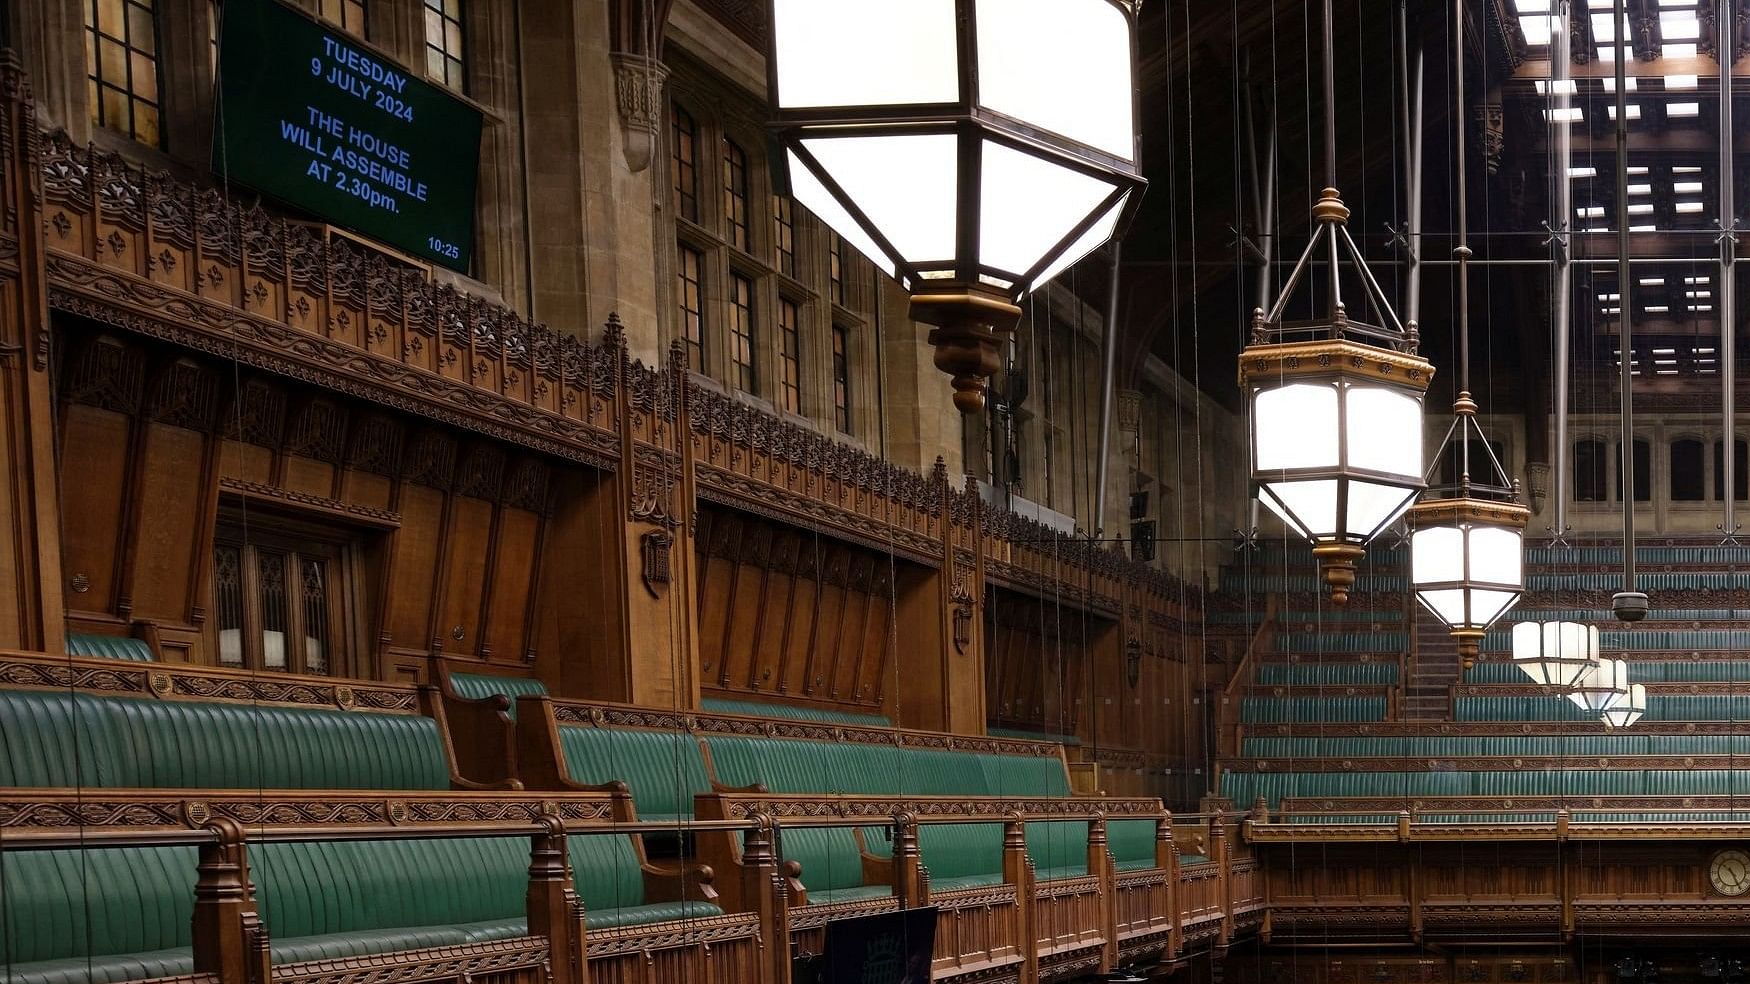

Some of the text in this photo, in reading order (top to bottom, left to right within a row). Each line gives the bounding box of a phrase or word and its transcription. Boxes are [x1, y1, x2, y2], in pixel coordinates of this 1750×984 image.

[311, 58, 414, 123] 9 JULY 2024
[323, 36, 406, 94] TUESDAY
[281, 119, 427, 202] WILL ASSEMBLE
[307, 106, 410, 169] THE HOUSE
[307, 160, 400, 214] AT 2.30pm.
[428, 236, 459, 259] 10:25
